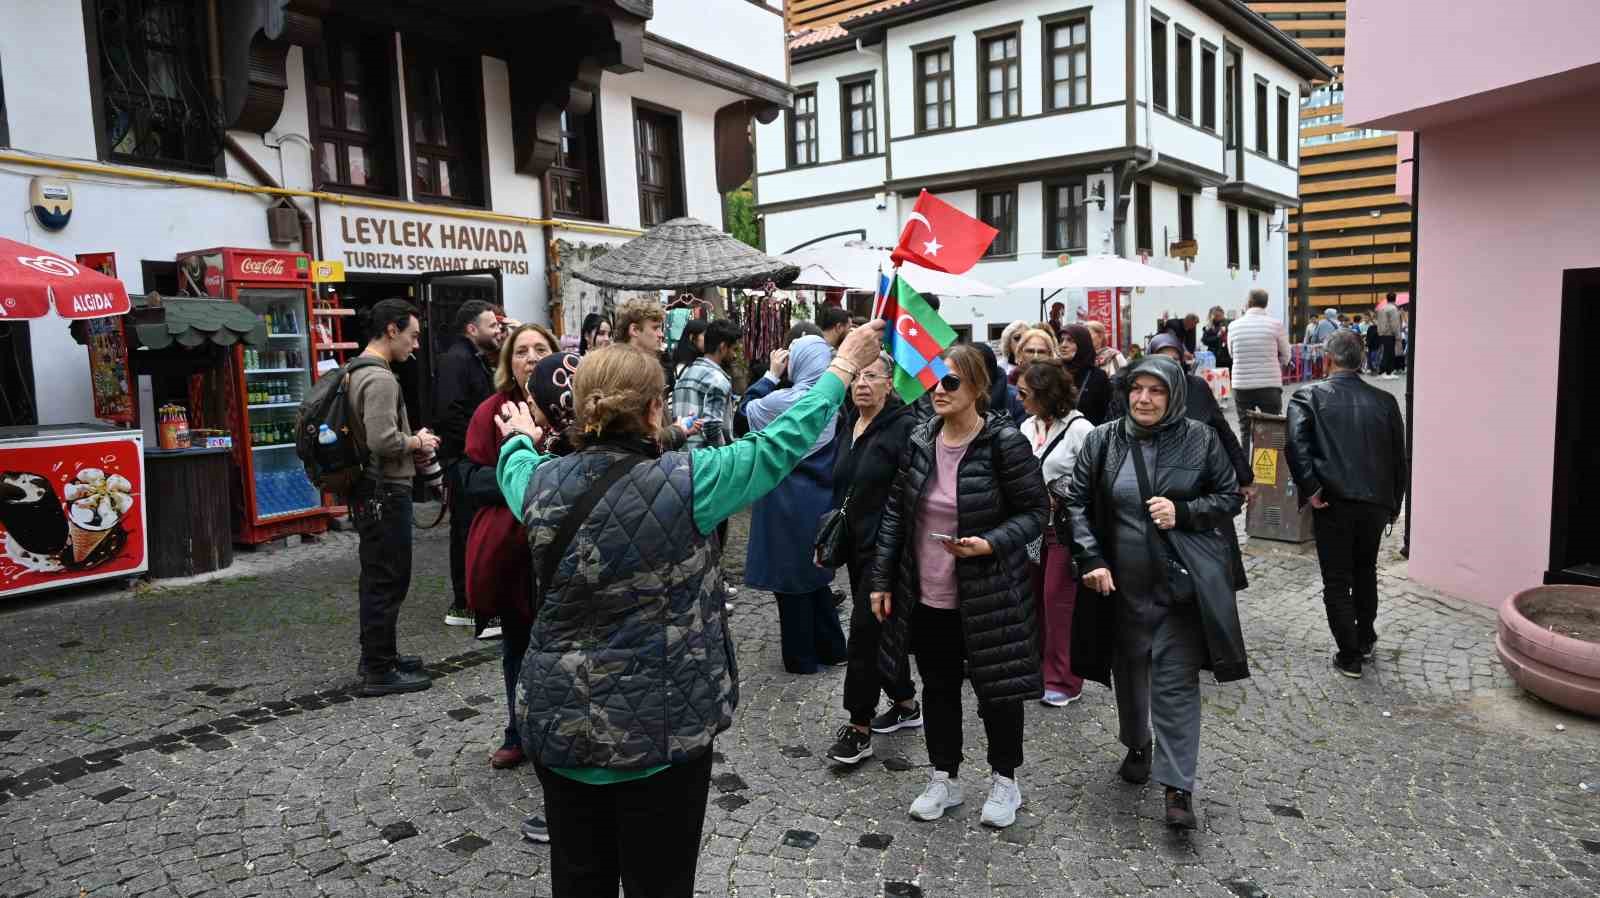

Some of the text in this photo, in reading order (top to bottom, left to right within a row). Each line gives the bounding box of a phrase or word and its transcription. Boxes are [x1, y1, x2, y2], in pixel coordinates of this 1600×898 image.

[341, 215, 528, 254] LEYLEK HAVADA
[343, 250, 404, 270] TURIZM
[407, 254, 468, 272] SEYAHAT
